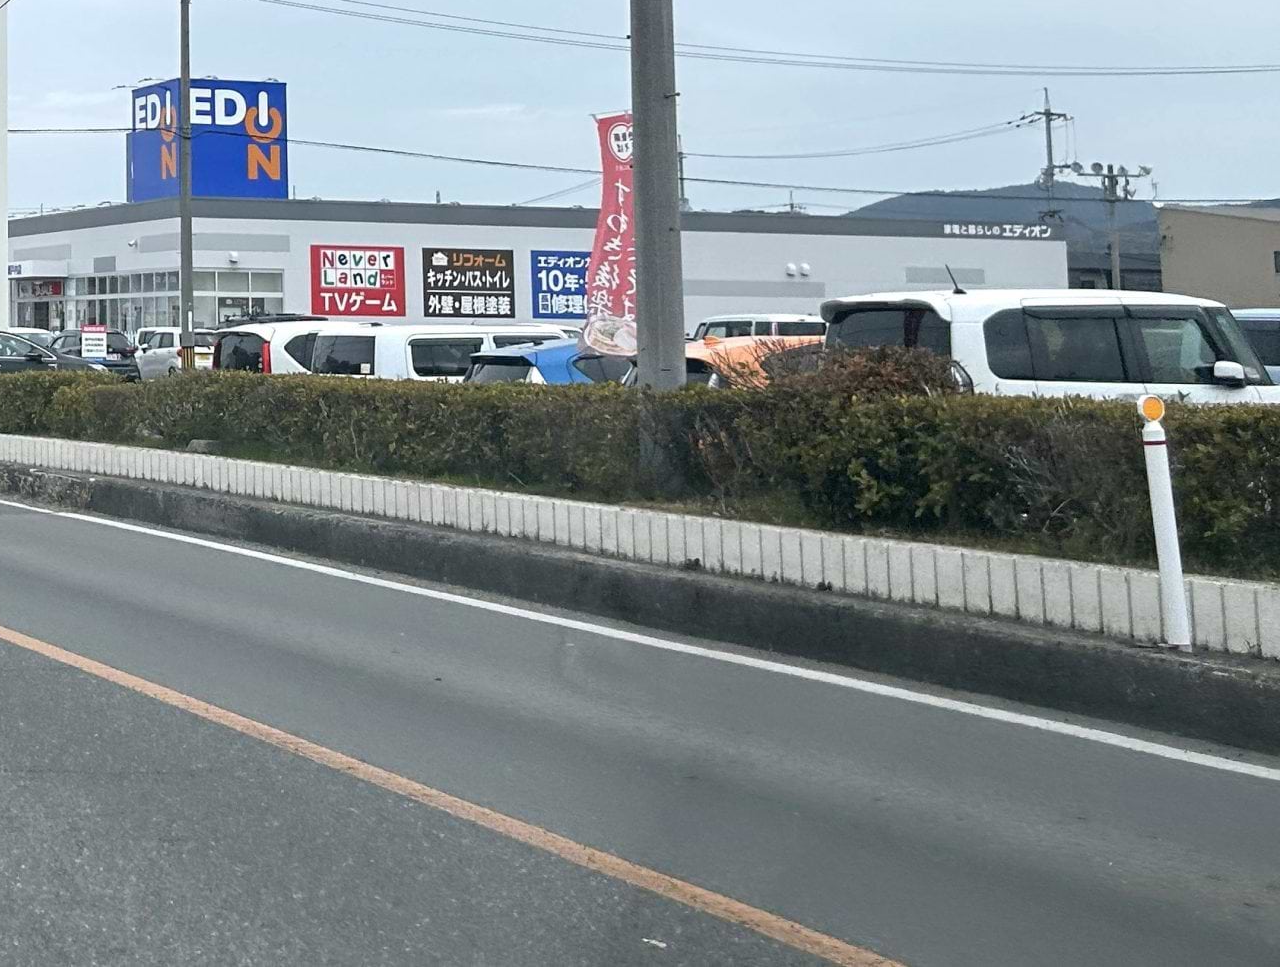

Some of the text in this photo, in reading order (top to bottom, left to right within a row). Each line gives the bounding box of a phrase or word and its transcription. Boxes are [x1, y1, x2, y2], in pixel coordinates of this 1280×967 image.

[1002, 225, 1051, 237] エディオン
[322, 251, 391, 267] Never
[453, 252, 506, 267] リフォーム
[323, 270, 378, 286] Land
[537, 270, 588, 292] 10年・
[320, 292, 397, 312] TVゲーム
[428, 295, 511, 314] 外壁・屋根塗装
